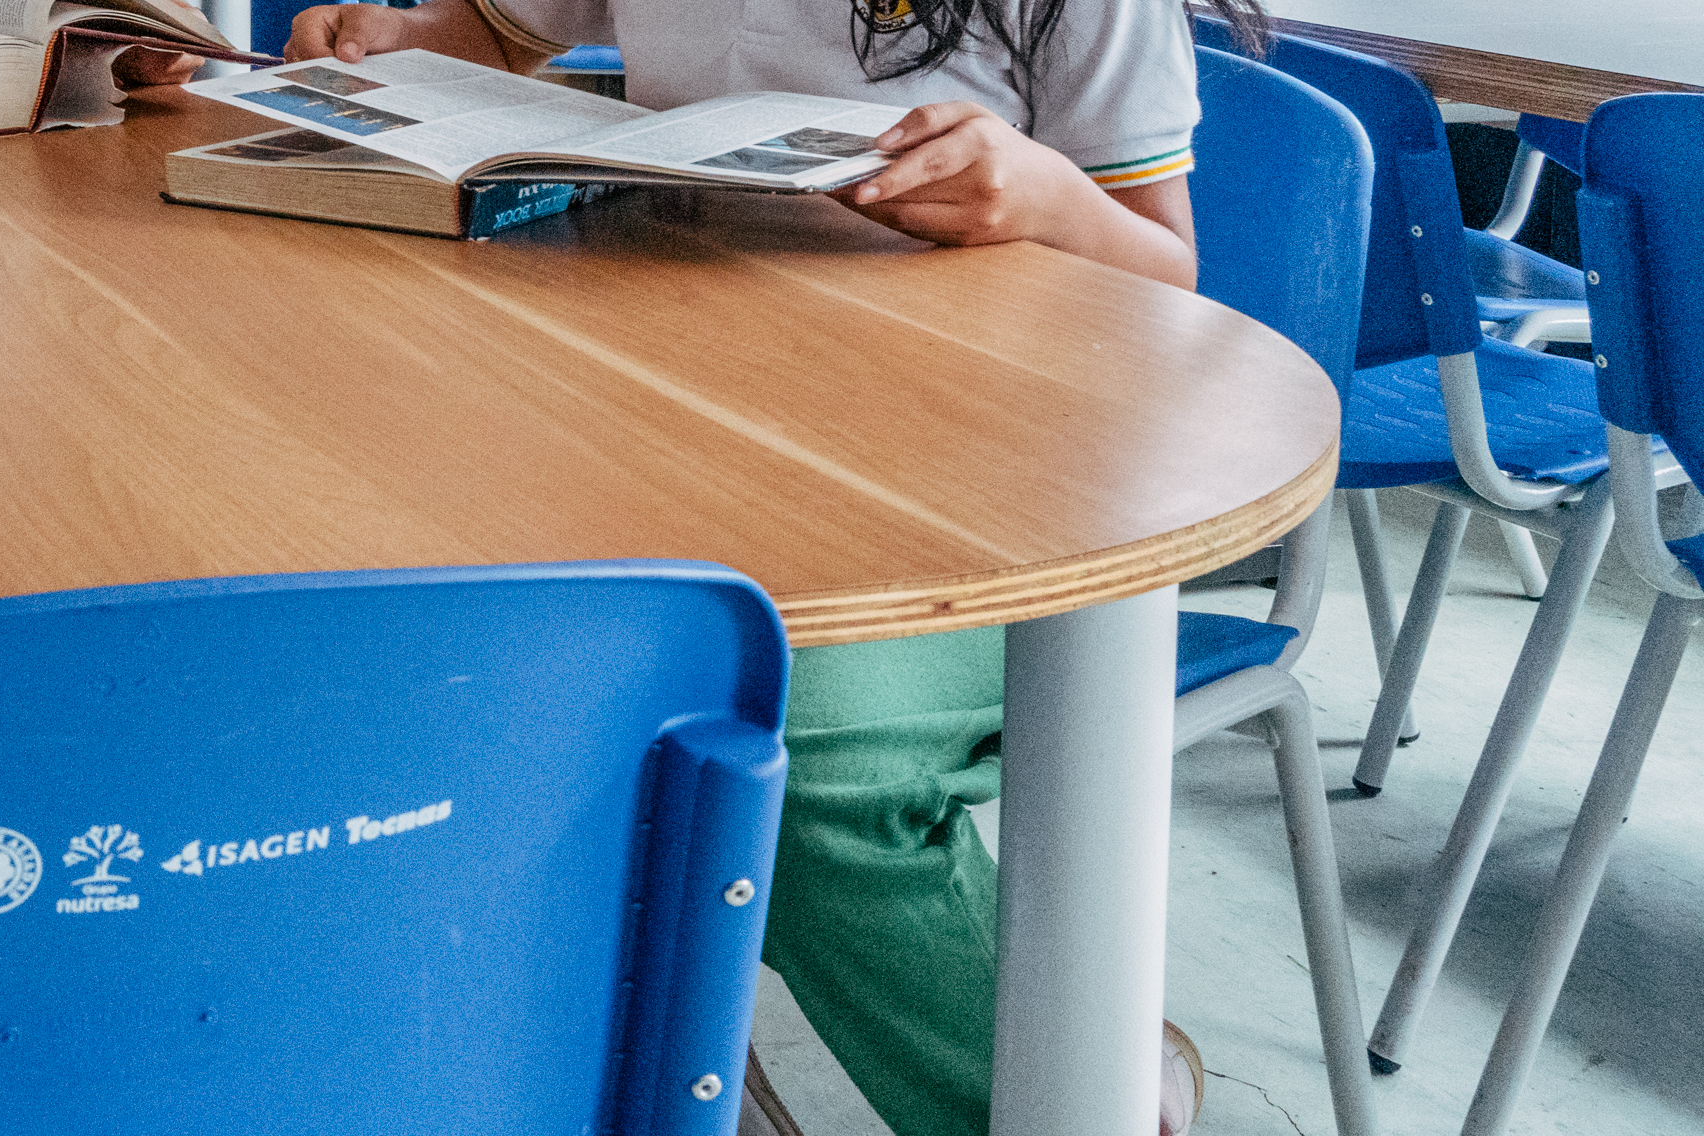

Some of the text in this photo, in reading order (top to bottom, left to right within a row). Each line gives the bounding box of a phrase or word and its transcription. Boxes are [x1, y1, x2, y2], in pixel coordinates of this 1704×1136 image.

[493, 203, 532, 230] BOOK
[206, 825, 331, 868] ISAGEN
[56, 893, 140, 914] nutresa
